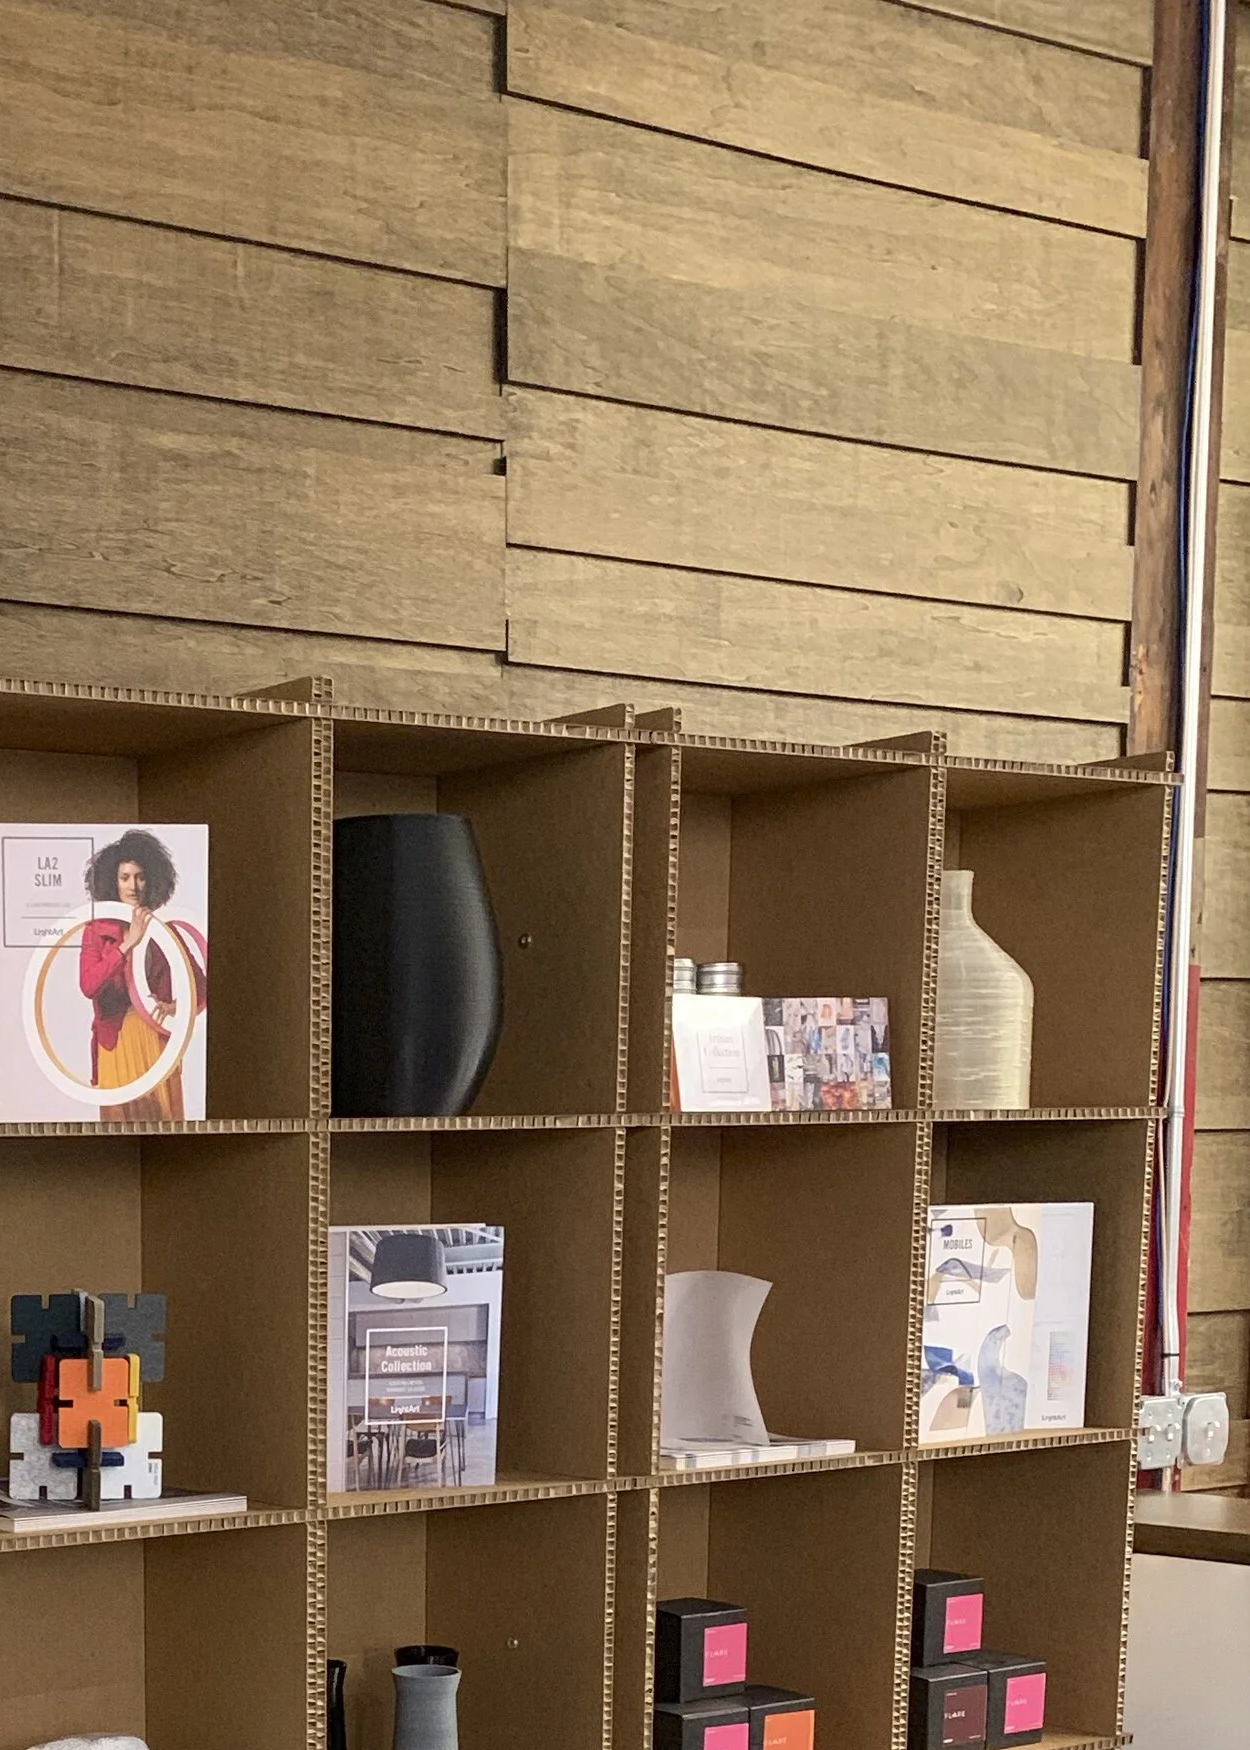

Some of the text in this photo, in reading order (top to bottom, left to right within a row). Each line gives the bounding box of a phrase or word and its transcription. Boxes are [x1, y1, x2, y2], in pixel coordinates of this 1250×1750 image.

[37, 856, 59, 870] LA2
[34, 873, 62, 887] SLIM
[33, 928, 63, 936] LightArt
[943, 1239, 973, 1250] MOBILES
[386, 1344, 428, 1357] Acoustic
[381, 1360, 432, 1373] Collection
[390, 1404, 420, 1415] LightArt
